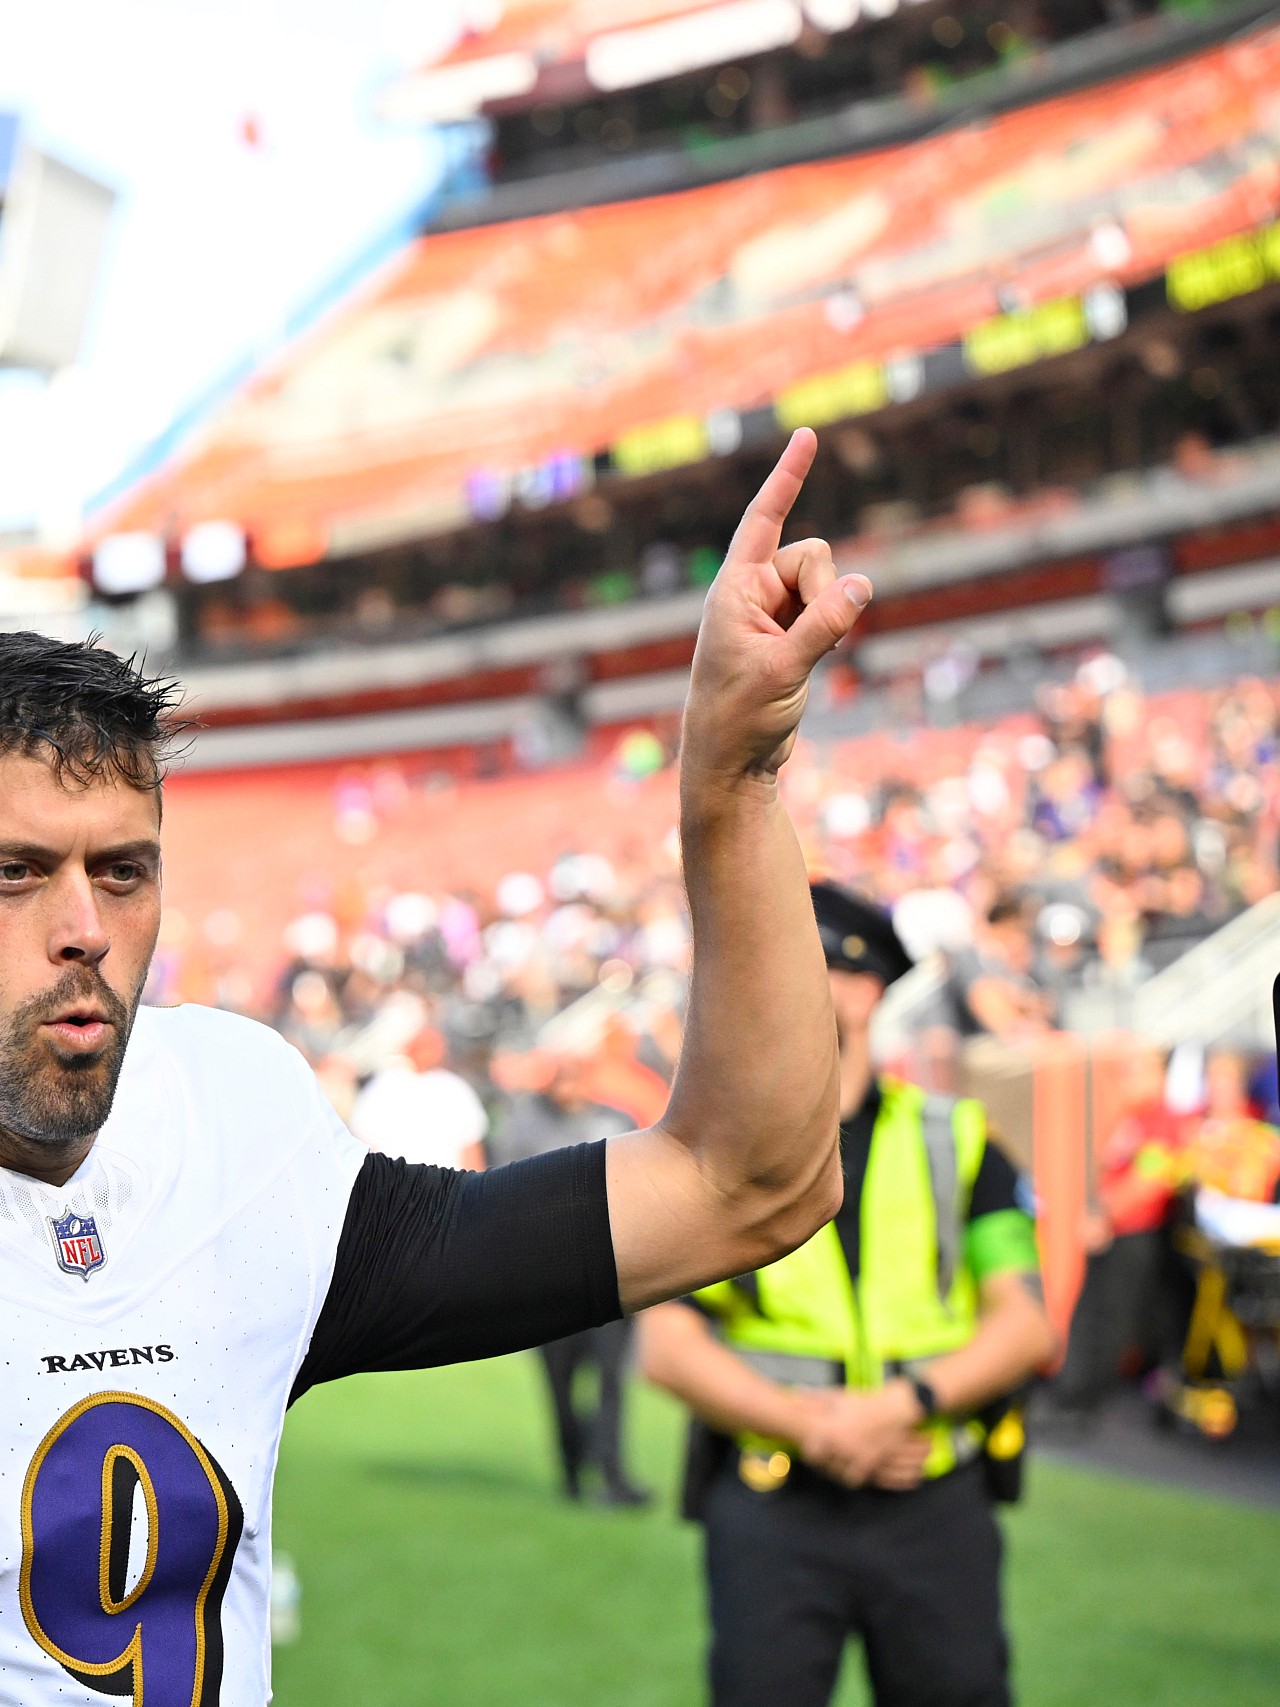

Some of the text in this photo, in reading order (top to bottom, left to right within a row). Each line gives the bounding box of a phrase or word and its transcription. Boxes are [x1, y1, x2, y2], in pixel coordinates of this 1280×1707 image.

[62, 1237, 101, 1267] NFL
[40, 1344, 174, 1374] RAVENS
[20, 1390, 244, 1707] 9
